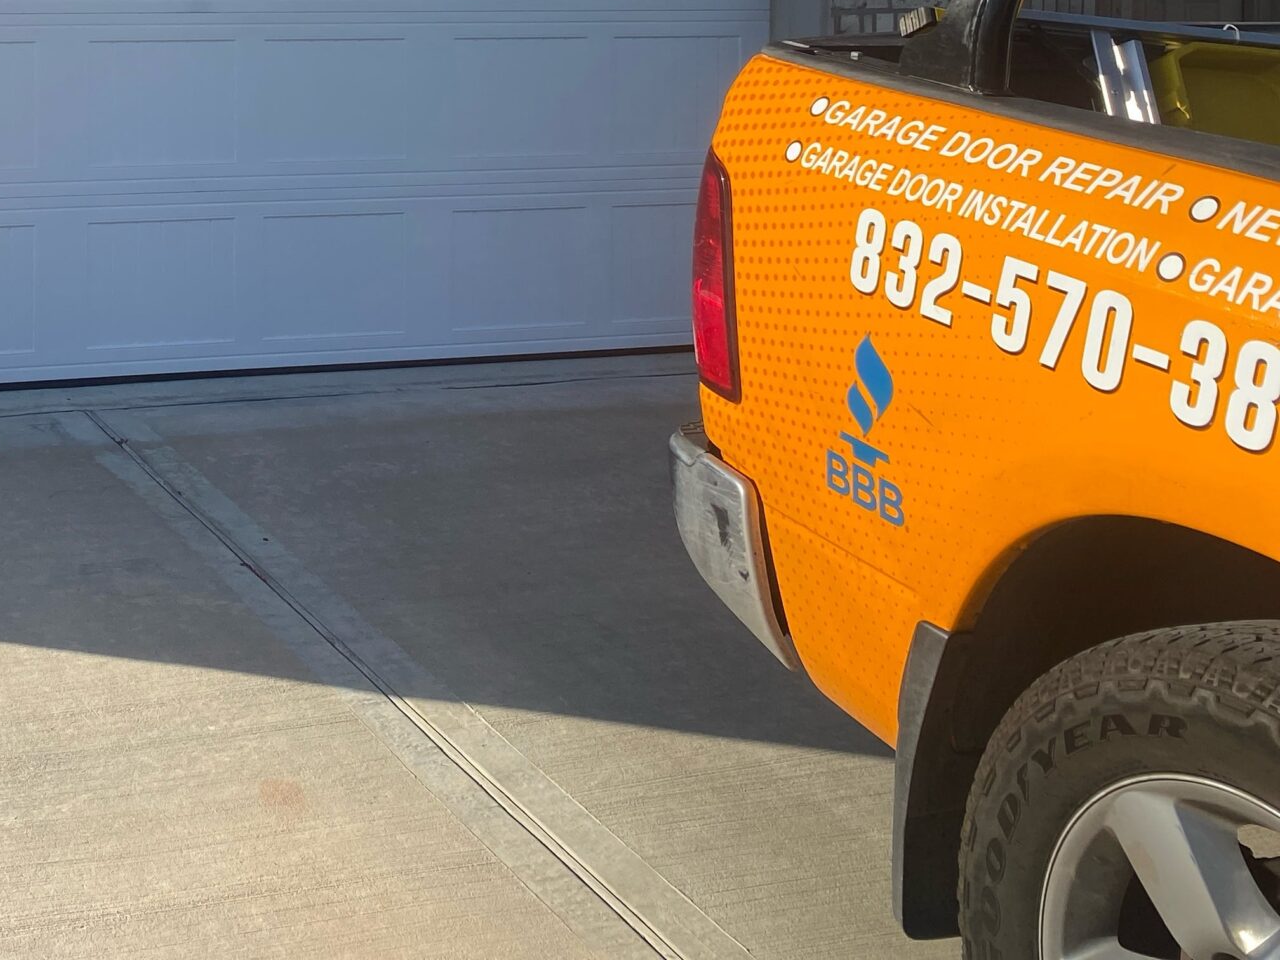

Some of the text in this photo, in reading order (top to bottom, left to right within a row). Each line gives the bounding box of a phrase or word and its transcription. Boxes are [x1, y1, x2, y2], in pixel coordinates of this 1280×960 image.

[801, 142, 893, 191] GARAGE
[887, 168, 963, 213] DOOR
[958, 188, 1162, 272] INSTALLATION
[824, 100, 1280, 246] GARAGE DOOR REPAIR NE
[849, 207, 1280, 453] 832-570-38
[826, 448, 905, 527] BBB
